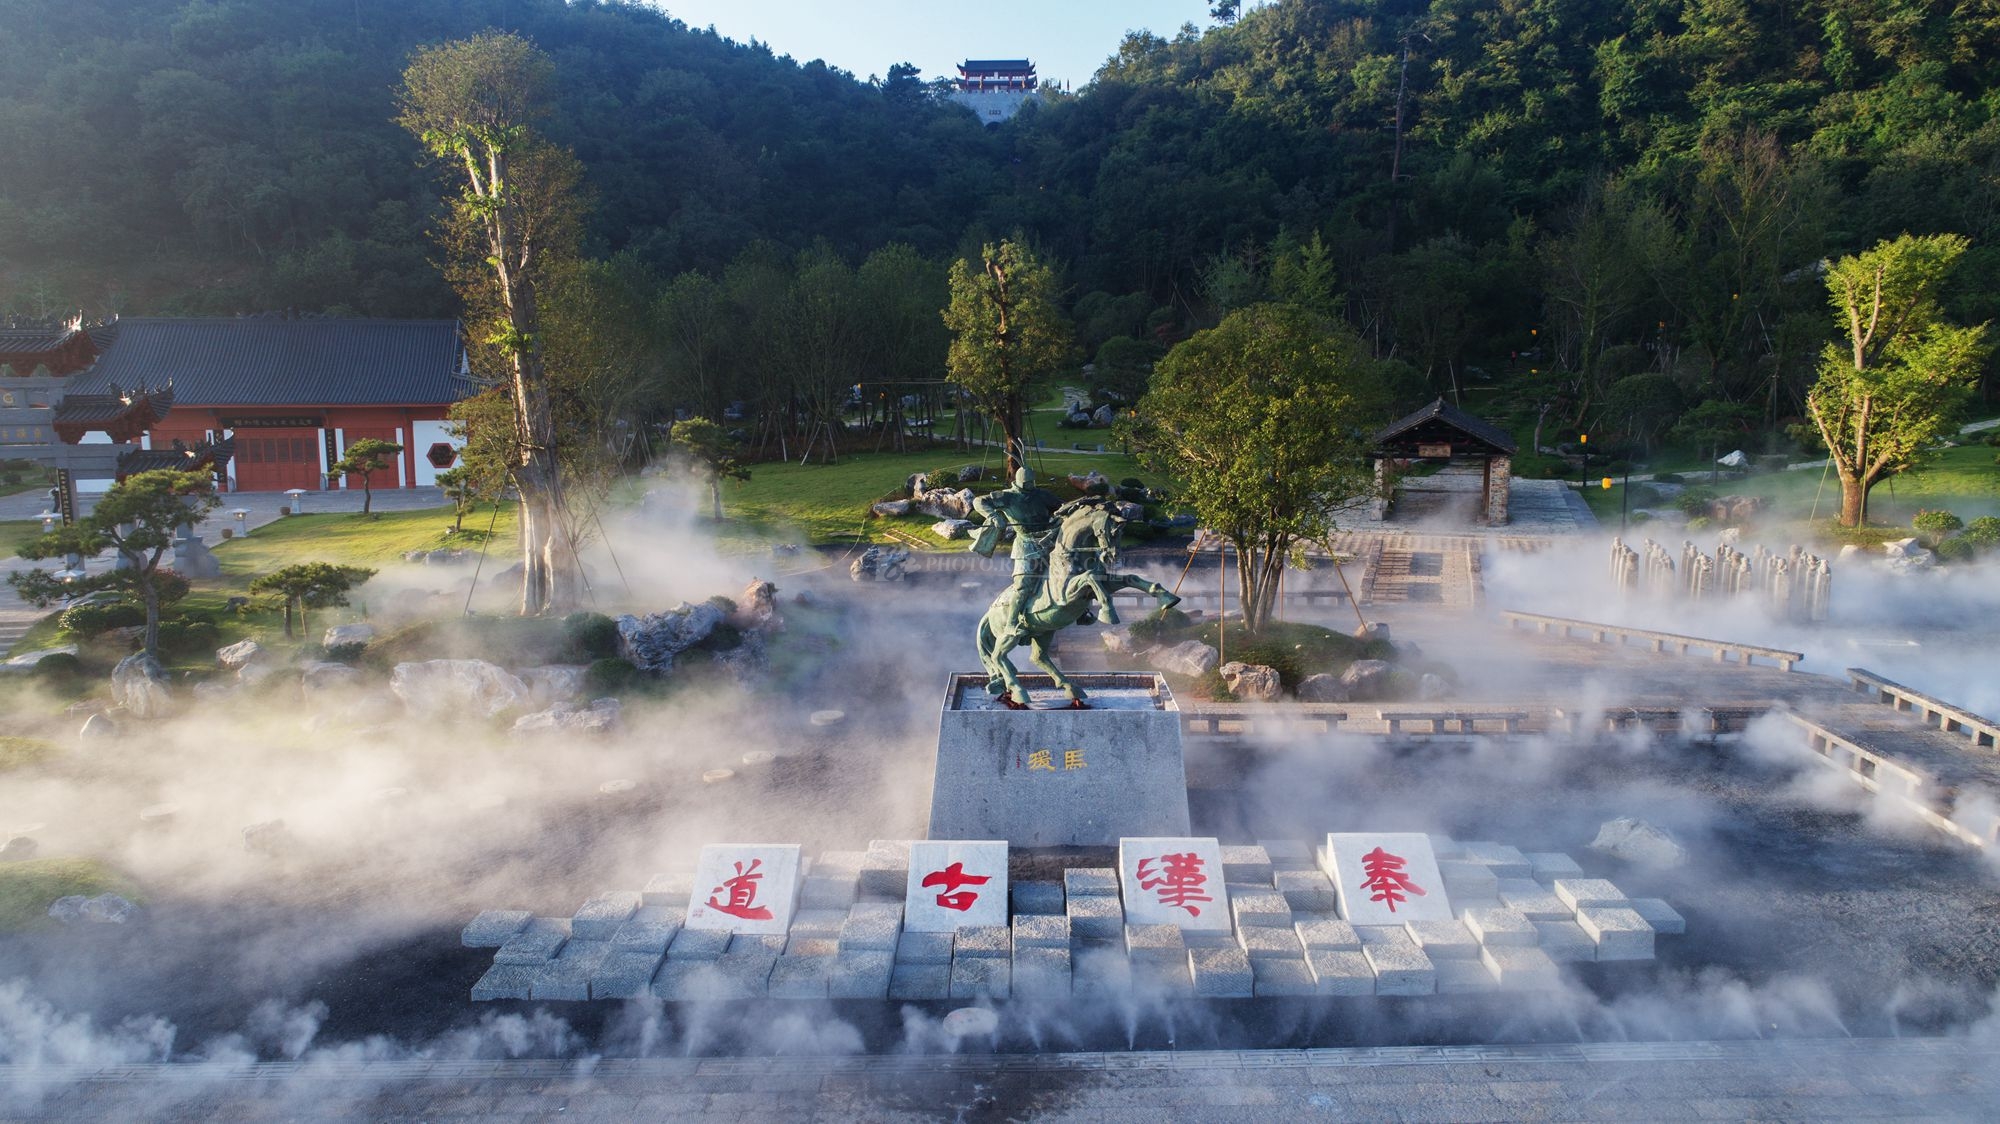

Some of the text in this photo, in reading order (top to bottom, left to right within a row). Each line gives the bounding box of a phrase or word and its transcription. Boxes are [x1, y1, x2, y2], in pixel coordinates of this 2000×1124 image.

[704, 858, 774, 921] 道
[922, 862, 992, 911] 古
[1360, 847, 1427, 912] 奉
